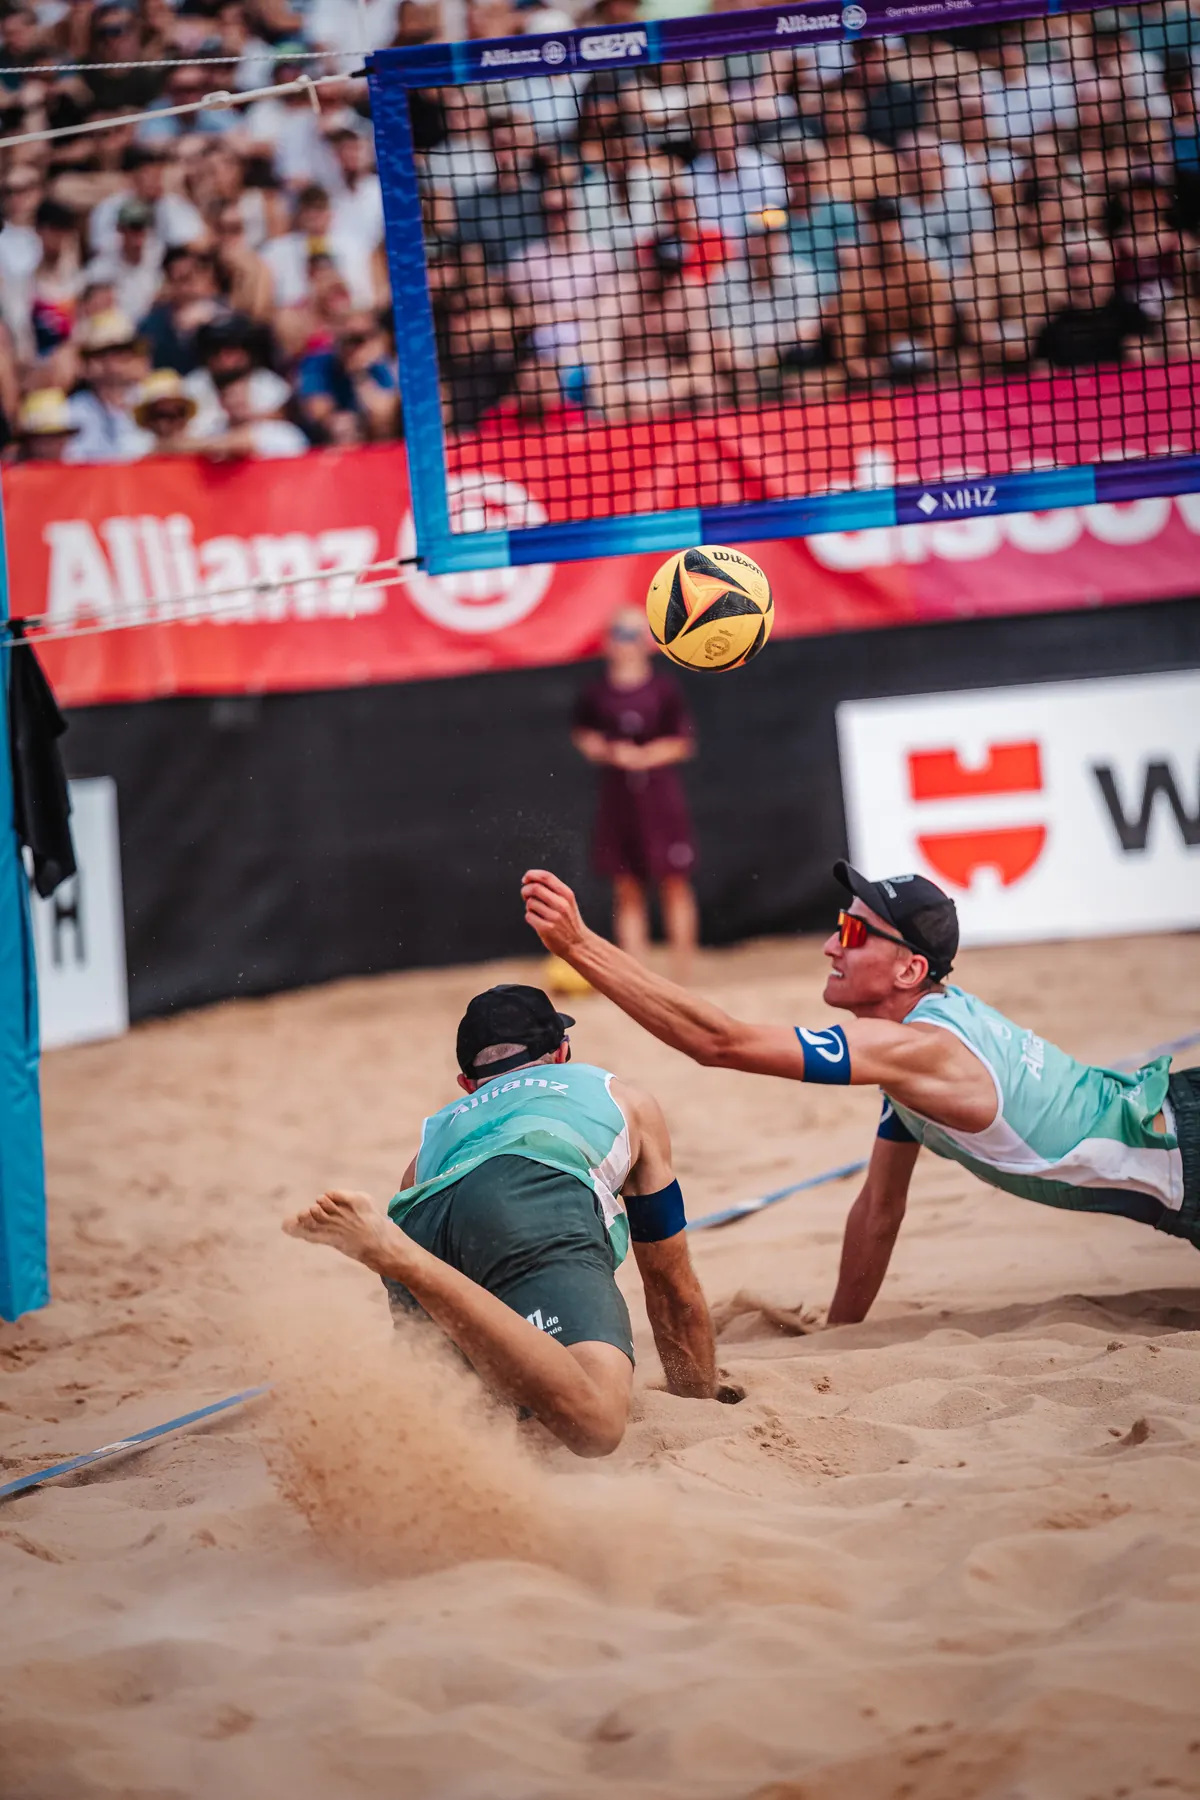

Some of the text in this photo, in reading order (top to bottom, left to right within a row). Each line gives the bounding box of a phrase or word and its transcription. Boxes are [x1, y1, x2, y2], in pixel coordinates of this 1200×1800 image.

[775, 13, 841, 35] Allianz
[480, 49, 542, 68] Allianz
[942, 485, 998, 511] MHZ
[42, 513, 387, 635] Allianz
[711, 551, 763, 578] Wilson
[451, 1077, 570, 1121] Allianz
